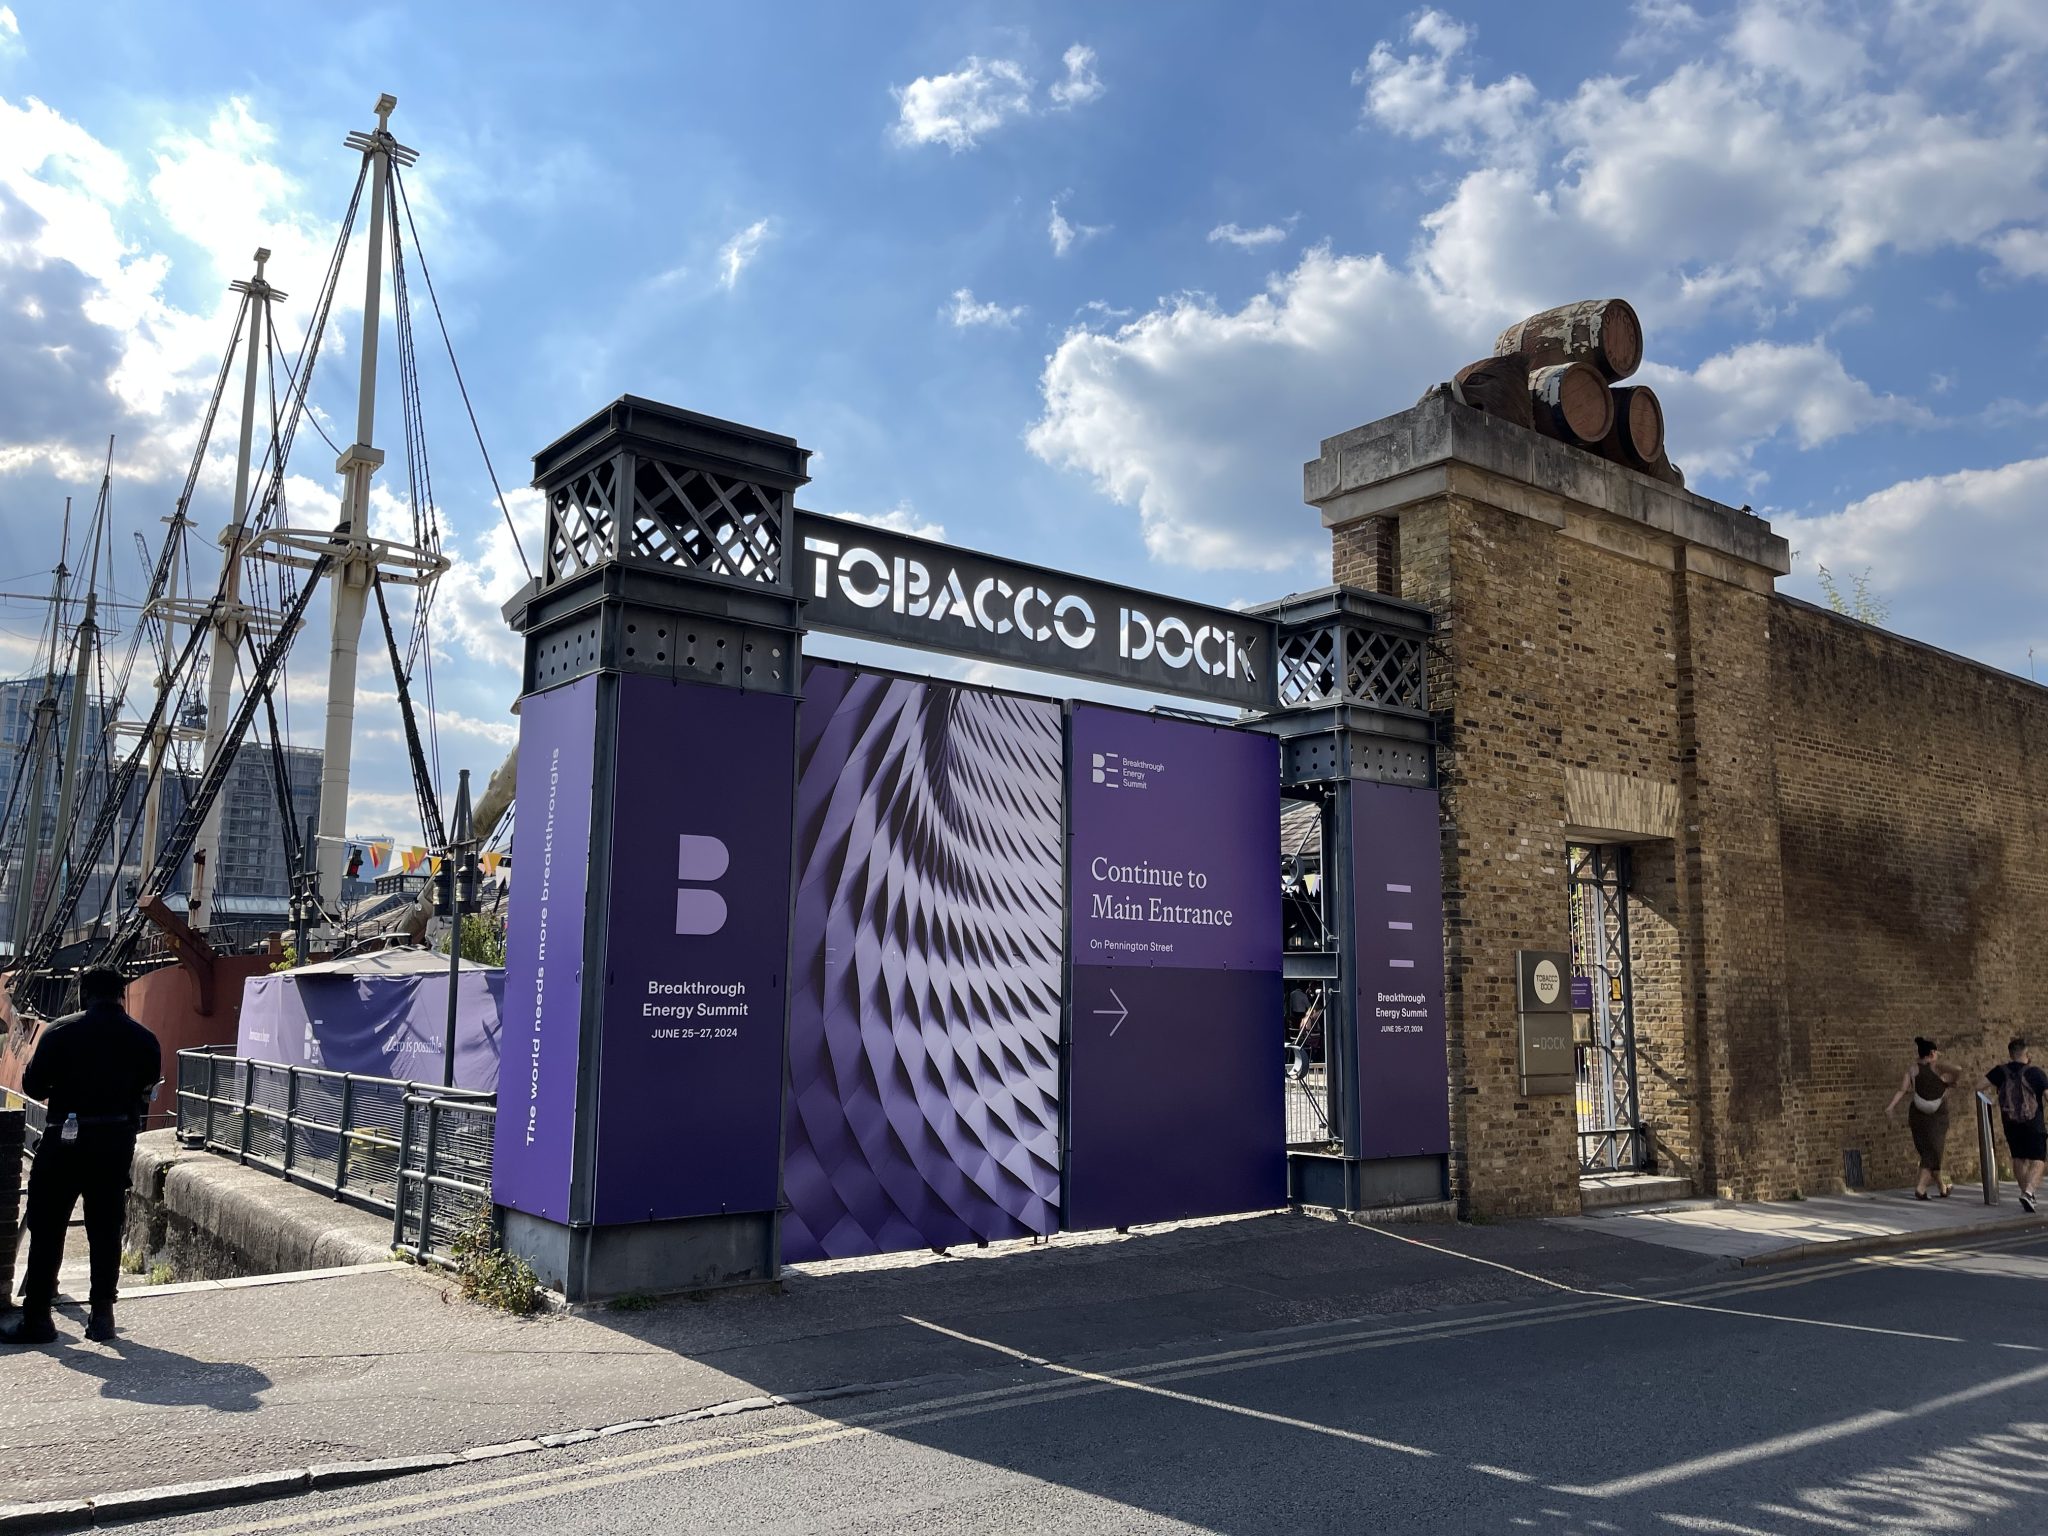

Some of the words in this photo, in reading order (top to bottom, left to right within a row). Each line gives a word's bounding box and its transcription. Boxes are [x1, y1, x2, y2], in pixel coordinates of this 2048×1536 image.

[803, 536, 1096, 649] TOBACCO
[1119, 608, 1257, 682] DOCK
[1122, 757, 1165, 773] Breakthrough
[1122, 768, 1145, 780] Energy
[1122, 778, 1147, 789] Summit
[541, 748, 559, 901] breakthroughs
[1091, 856, 1184, 887] Continue
[1188, 870, 1207, 889] to
[1091, 893, 1143, 921] Main
[1148, 897, 1233, 927] Entrance
[539, 907, 548, 961] more
[1090, 938, 1102, 949] On
[1104, 940, 1149, 953] Pennington
[1150, 941, 1174, 952] Street
[1536, 974, 1558, 983] TOBACCO
[1540, 982, 1554, 991] DOCK
[648, 980, 746, 998] Breakthrough
[535, 966, 545, 1032] needs
[1377, 992, 1426, 1005] Breakthrough
[642, 1003, 694, 1019] Energy
[697, 1002, 749, 1016] Summit
[1375, 1007, 1400, 1020] Energy
[1401, 1007, 1428, 1018] Summit
[651, 1029, 680, 1038] JUNE
[714, 1028, 738, 1038] 2024
[1381, 1025, 1395, 1033] JUNE
[1411, 1025, 1424, 1033] 2024
[386, 1036, 405, 1052] Zero
[407, 1036, 413, 1053] is
[413, 1035, 442, 1059] possible
[1540, 1036, 1566, 1051] DOCK
[531, 1038, 540, 1100] world
[526, 1105, 537, 1145] The
